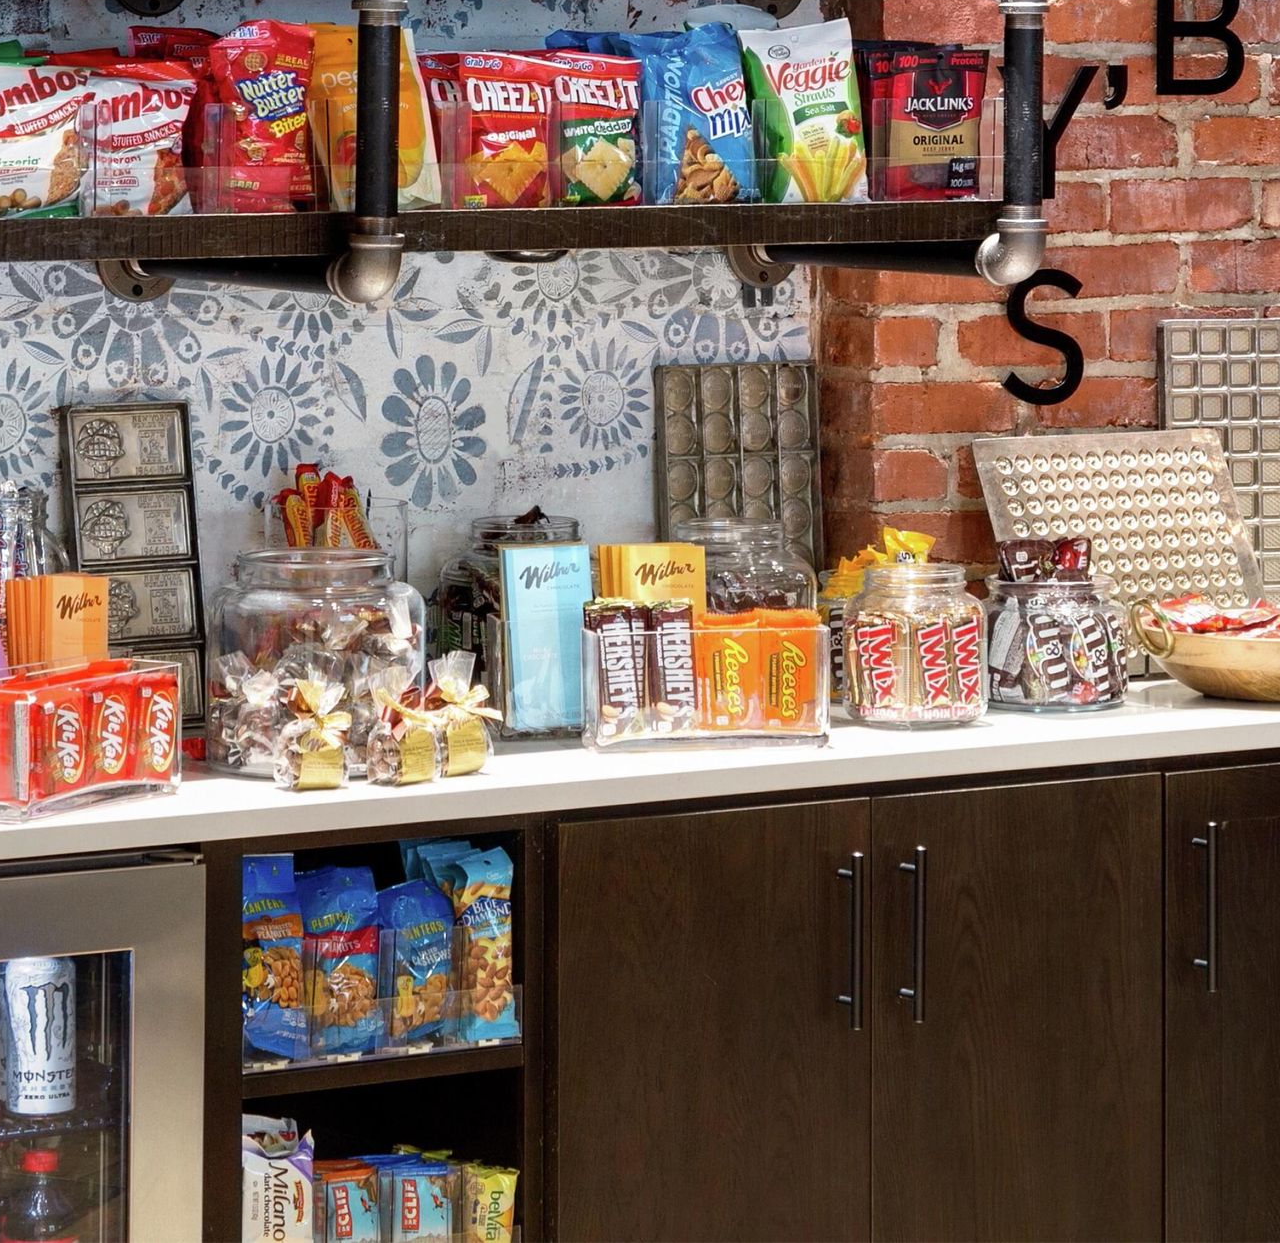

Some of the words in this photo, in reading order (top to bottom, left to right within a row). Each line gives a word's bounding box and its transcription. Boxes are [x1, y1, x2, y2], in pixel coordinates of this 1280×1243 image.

[285, 56, 309, 66] REAL
[465, 56, 483, 68] Grab
[491, 60, 502, 69] Go
[581, 61, 593, 71] Go
[793, 57, 826, 73] garden
[899, 55, 919, 68] 100
[951, 58, 984, 66] Protein
[239, 70, 297, 101] Nutter
[766, 59, 851, 96] Veggie
[252, 84, 306, 119] Butter
[692, 75, 746, 114] Chex
[794, 87, 836, 107] Straws
[905, 97, 935, 112] JACK
[937, 96, 974, 111] LINK'S
[14, 116, 47, 136] STUFFED
[47, 99, 79, 126] SNACKS
[804, 106, 820, 116] Sea
[820, 104, 836, 114] Salt
[111, 132, 144, 149] STUFFED
[145, 123, 177, 143] SNACKS
[271, 112, 307, 138] Bites
[913, 134, 965, 146] ORIGINAL
[519, 560, 581, 590] Wilbur
[634, 560, 696, 586] Wilbur
[56, 592, 102, 620] Wilbur
[723, 637, 749, 717] Reese's
[781, 640, 807, 719] Reese's
[472, 899, 498, 914] BLUE
[256, 928, 292, 939] PEANUTS
[48, 1092, 71, 1100] ULTRA
[263, 1172, 272, 1193] dark
[268, 1161, 291, 1242] Milano
[334, 1188, 352, 1225] CLIF
[403, 1182, 418, 1218] CLIF
[263, 1195, 273, 1238] chocolate
[485, 1190, 505, 1241] belVita
